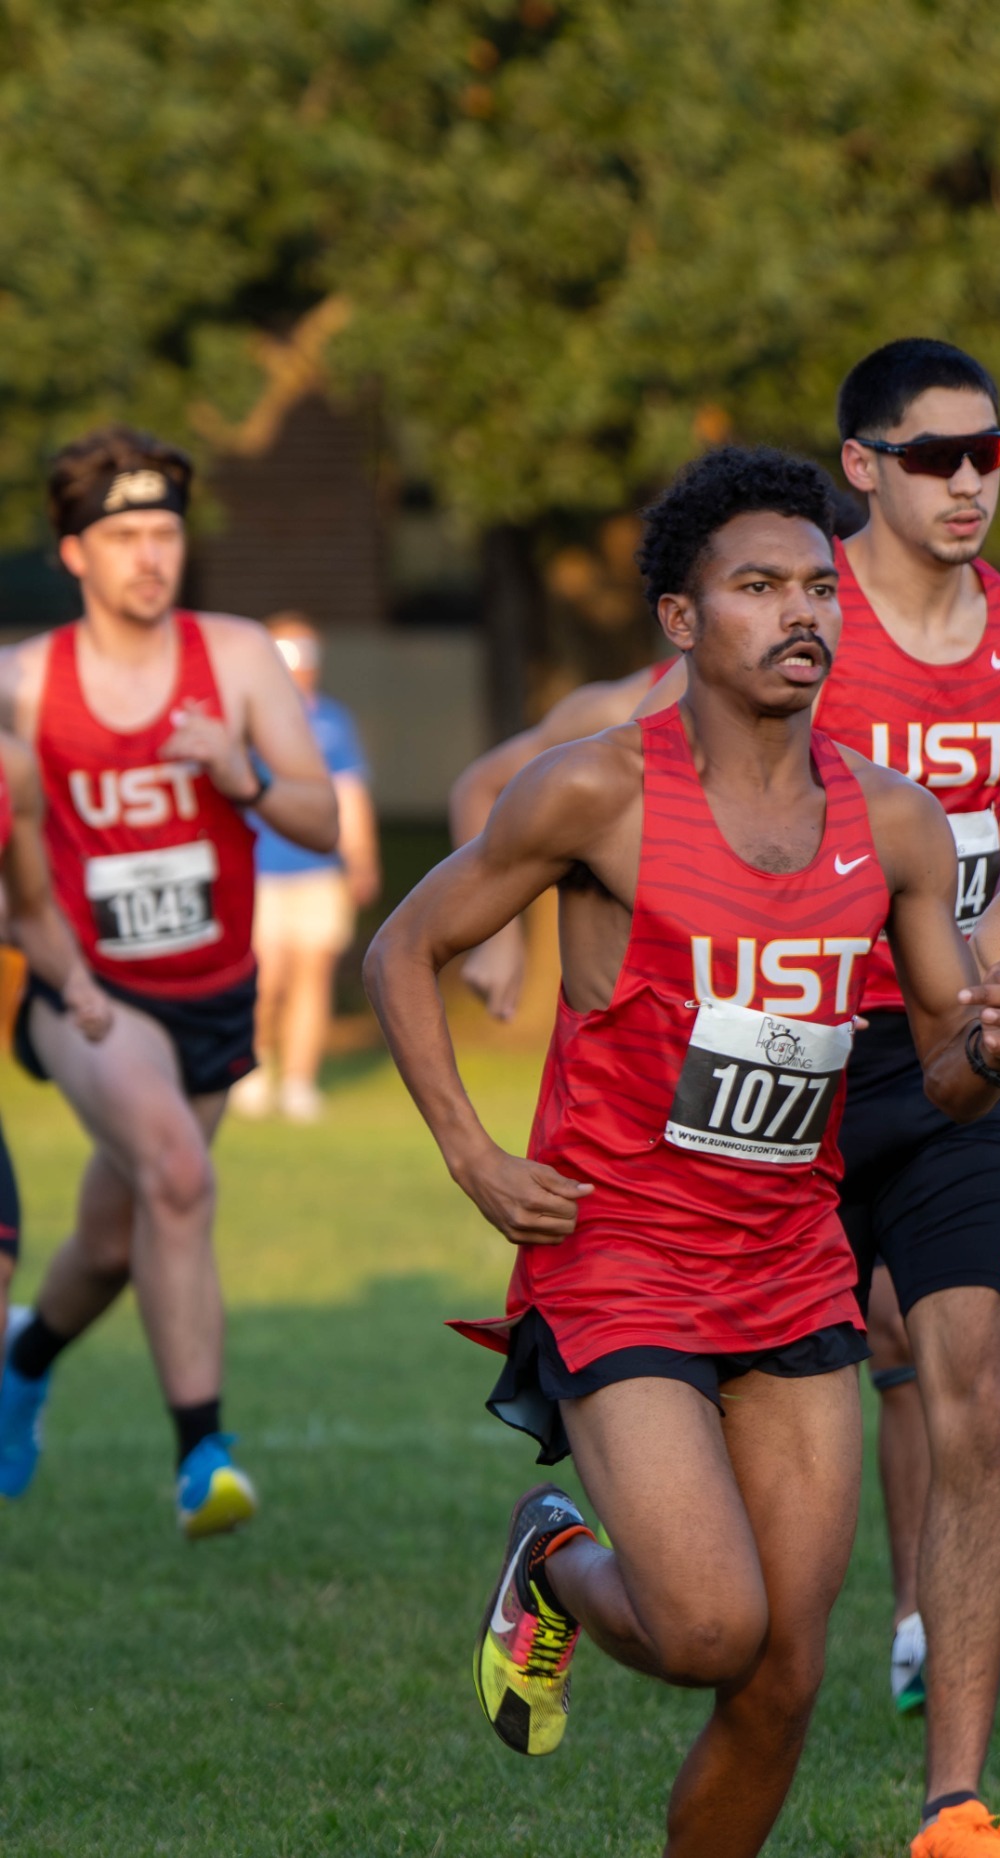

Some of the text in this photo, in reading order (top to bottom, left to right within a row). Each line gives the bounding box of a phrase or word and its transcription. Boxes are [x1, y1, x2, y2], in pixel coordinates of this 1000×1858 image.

[68, 761, 201, 829] UST
[691, 936, 872, 1016] UST
[708, 1063, 830, 1141] 1077
